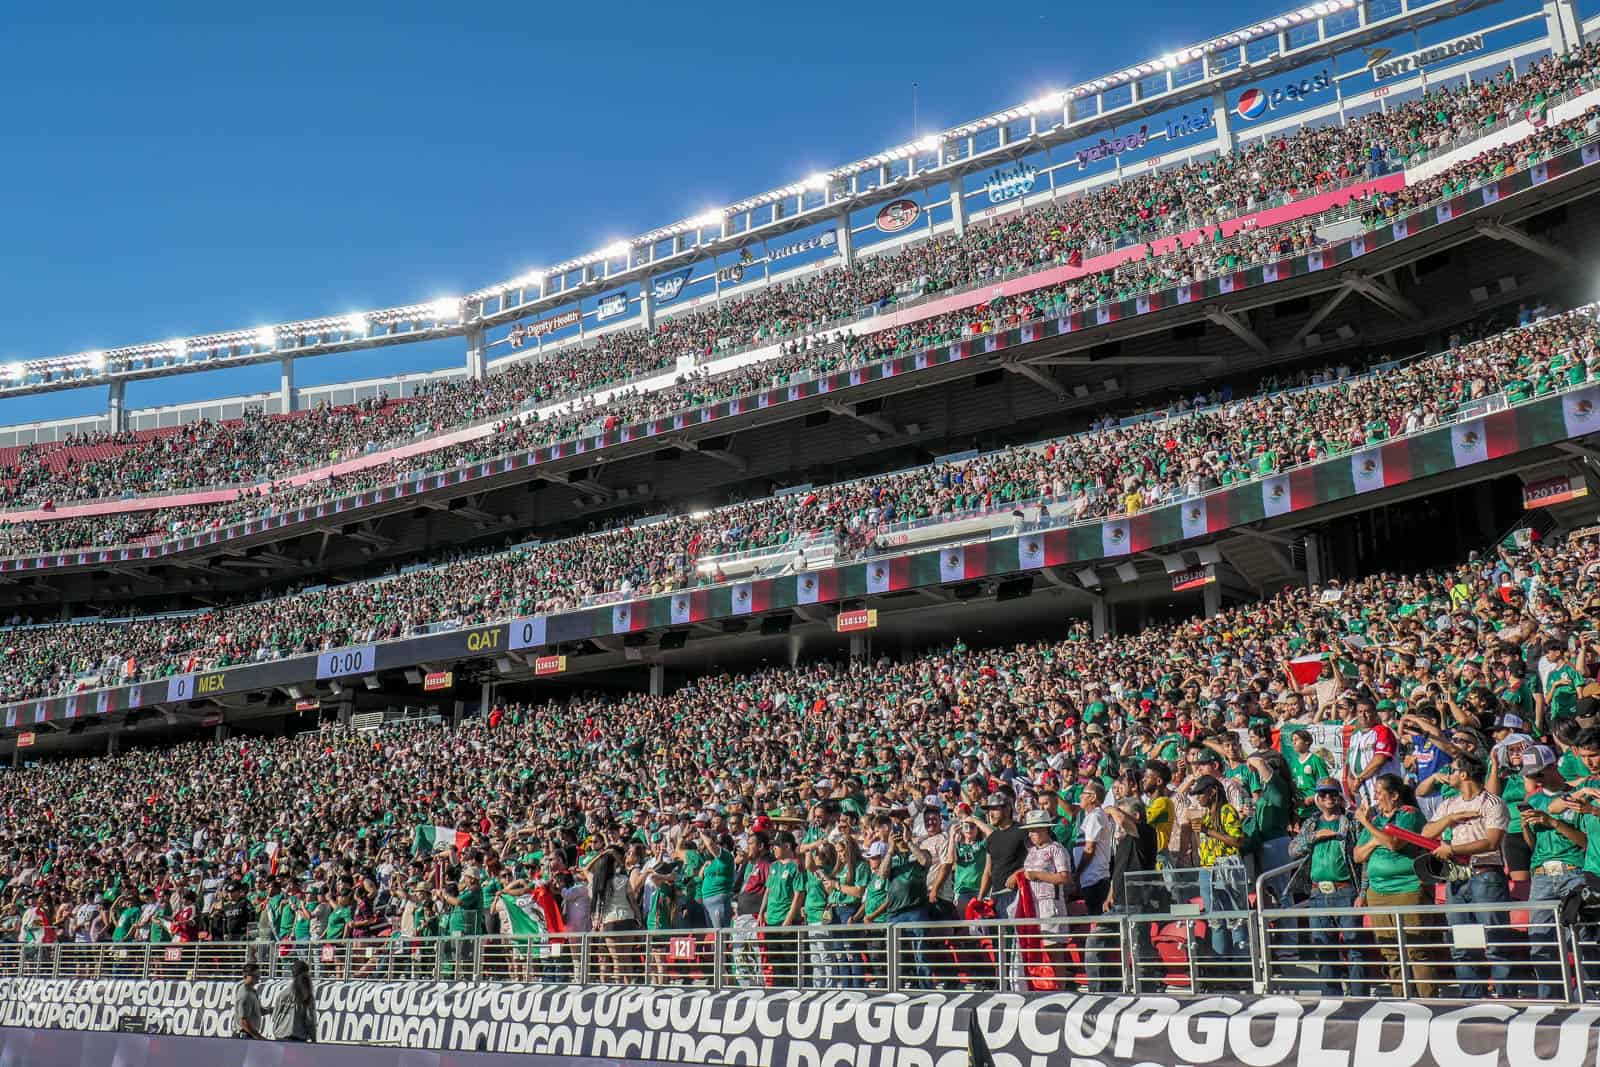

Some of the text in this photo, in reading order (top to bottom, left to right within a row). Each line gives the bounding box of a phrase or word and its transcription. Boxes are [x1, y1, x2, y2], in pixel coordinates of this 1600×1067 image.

[656, 276, 684, 298] SAP
[467, 623, 533, 651] QAT 0
[330, 651, 362, 674] 0:00
[177, 674, 225, 697] 0 MEX
[675, 940, 690, 957] 121
